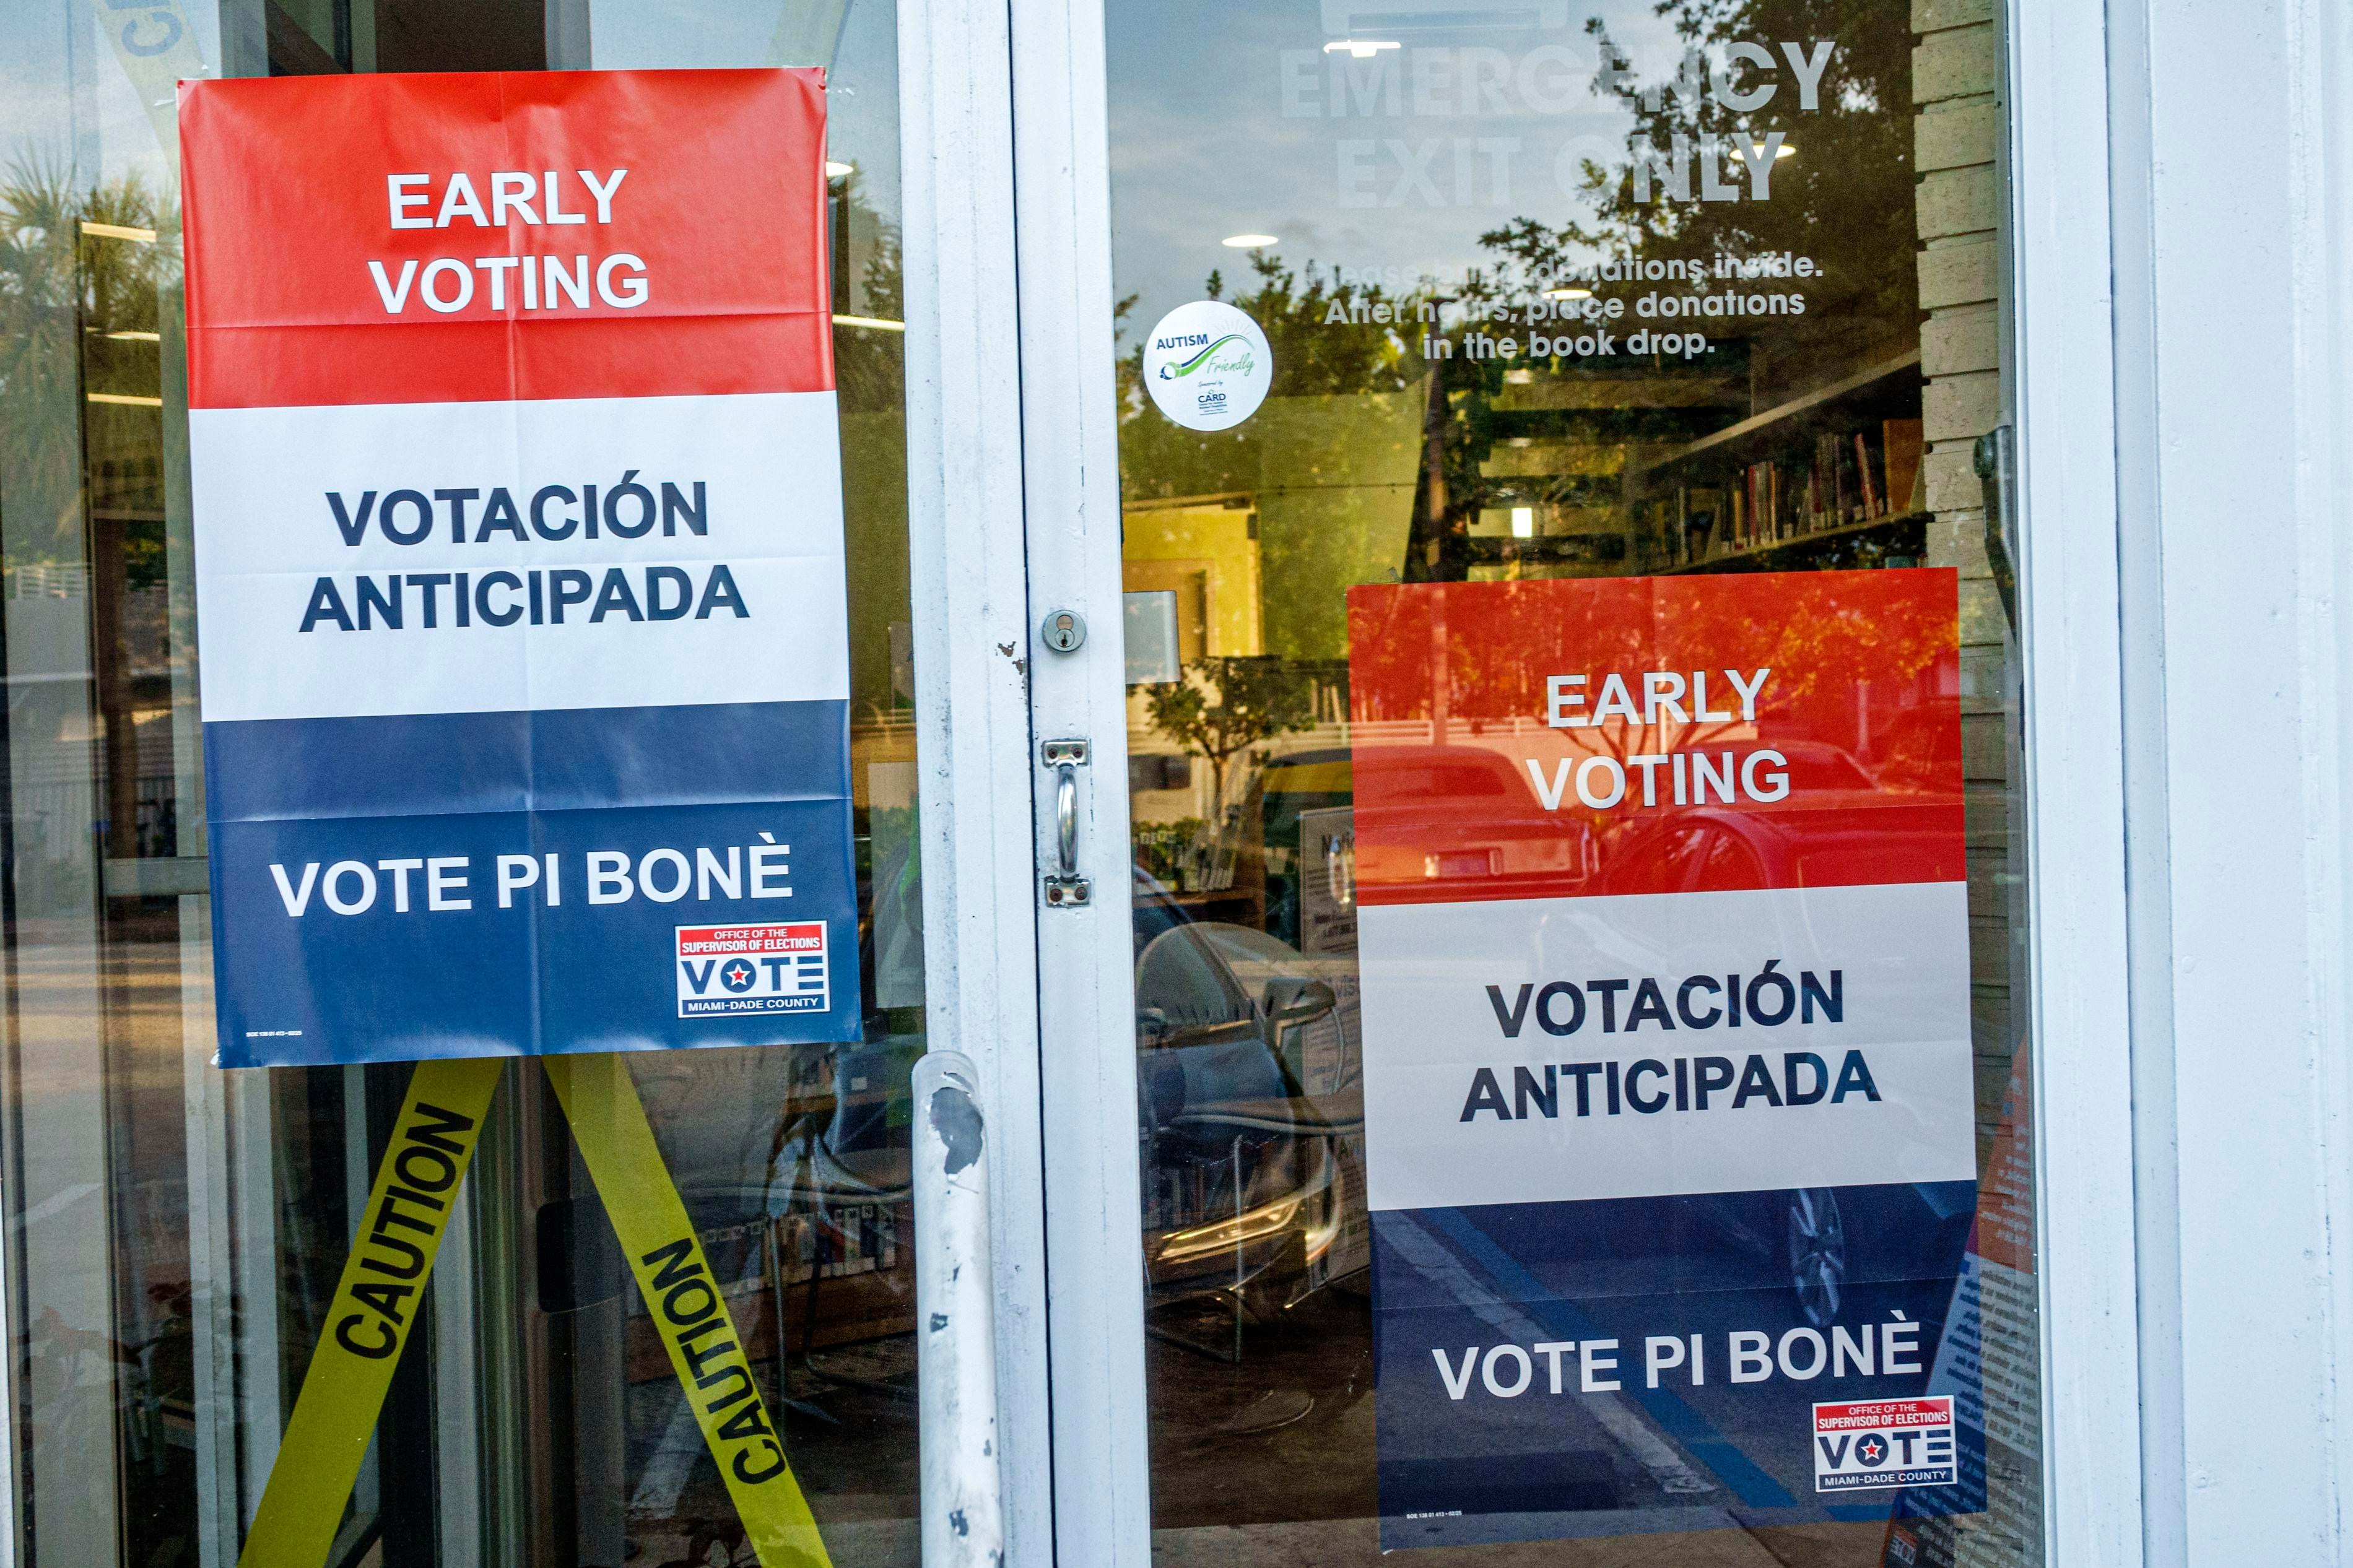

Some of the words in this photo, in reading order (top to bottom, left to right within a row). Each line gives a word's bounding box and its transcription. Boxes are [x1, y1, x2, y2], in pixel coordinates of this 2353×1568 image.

[1279, 41, 1836, 118] EMERGENCY
[1337, 136, 1521, 209] EXIT
[1553, 131, 1787, 203] ONLY
[386, 168, 629, 230] EARLY
[367, 253, 649, 314] VOTING
[1533, 254, 1703, 282] donations
[1714, 251, 1824, 279] inside.
[1324, 297, 1406, 325] After
[1526, 293, 1625, 326] place
[1635, 289, 1806, 318] donations
[1156, 333, 1209, 350] AUTISM
[1206, 352, 1255, 377] Friendly
[1424, 332, 1453, 360] in
[1463, 332, 1518, 359] the
[1529, 329, 1617, 358] book
[1627, 328, 1715, 360] drop.
[1198, 393, 1226, 403] CARD
[324, 469, 708, 547] VOTACIÓN
[298, 564, 750, 633] ANTICIPADA
[1546, 667, 1772, 728] EARLY
[1525, 748, 1791, 811] VOTING
[269, 855, 472, 918] VOTE
[497, 852, 561, 909] PI
[586, 831, 793, 905] BONÈ
[682, 940, 747, 953] SUPERVISOR
[748, 939, 763, 951] OF
[764, 937, 820, 951] ELECTIONS
[713, 930, 750, 940] OFFICE
[751, 929, 766, 938] OF
[768, 928, 788, 938] THE
[681, 955, 824, 995] VOTE
[1485, 959, 1844, 1038] VOTACIÓN
[687, 1000, 763, 1011] MIAMI-DADE
[767, 998, 819, 1008] COUNTY
[1459, 1049, 1882, 1122] ANTICIPADA
[336, 1102, 475, 1359] CAUTION
[642, 1237, 786, 1485] CAUTION
[1432, 1338, 1621, 1401] VOTE
[1645, 1333, 1704, 1389] PI
[1729, 1309, 1922, 1384] BONÈ
[1818, 1415, 1880, 1429] SUPERVISOR
[1881, 1414, 1894, 1425] OF
[1895, 1411, 1949, 1425] ELECTIONS
[1848, 1406, 1882, 1415] OFFICE
[1884, 1405, 1897, 1414] OF
[1898, 1403, 1917, 1413] THE
[1817, 1429, 1952, 1470] VOTE
[1825, 1474, 1895, 1486] MIAMI-DADE
[1898, 1471, 1947, 1482] COUNTY
